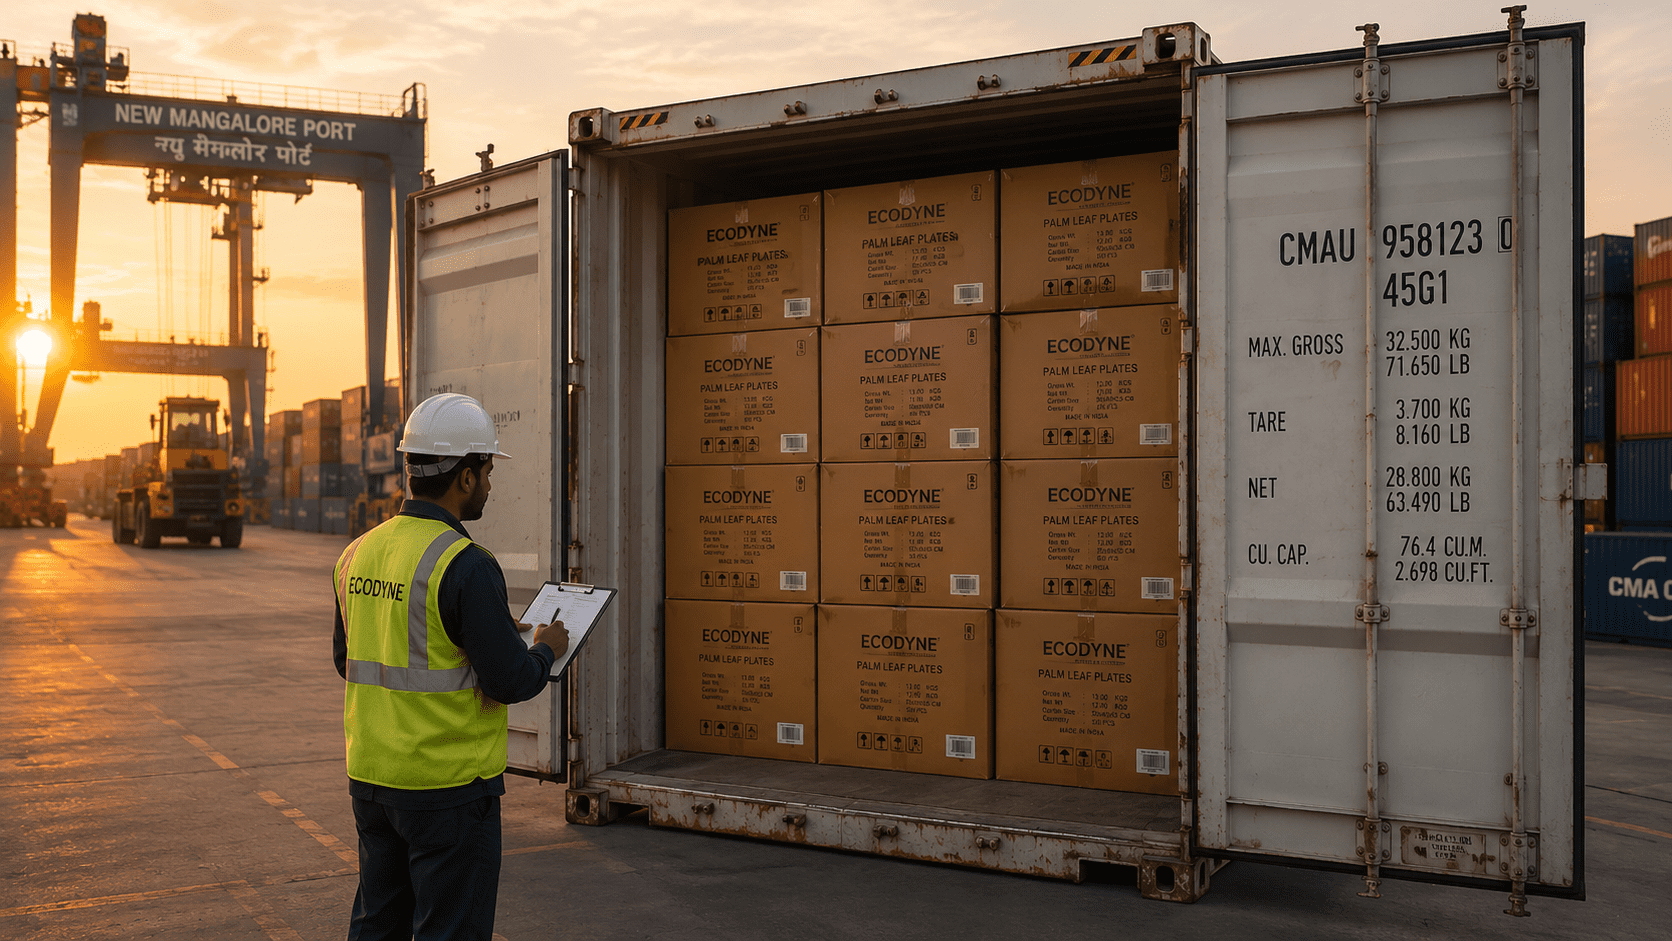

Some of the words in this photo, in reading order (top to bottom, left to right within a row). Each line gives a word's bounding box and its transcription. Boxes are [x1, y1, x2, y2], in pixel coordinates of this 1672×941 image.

[115, 103, 162, 125] NEW
[170, 107, 297, 136] MANGALORE
[303, 119, 356, 141] PORT
[275, 140, 313, 166] पोर्ट
[1048, 183, 1131, 206] ECODYNE
[868, 203, 945, 224] ECODYNE
[1043, 217, 1070, 228] PALM
[1073, 214, 1097, 226] LEAF
[1099, 211, 1138, 223] PLATES
[706, 222, 778, 243] ECODYNE
[862, 237, 888, 249] PALM
[890, 235, 915, 247] LEAF
[1279, 228, 1356, 267] CMAU
[1382, 219, 1483, 259] 958123
[1501, 218, 1512, 250] 0
[1382, 269, 1447, 308] 45G1
[1047, 335, 1131, 354] ECODYNE
[1248, 336, 1286, 358] MAX.
[1292, 333, 1344, 356] GROSS
[1385, 329, 1440, 352] 32.500
[1449, 328, 1471, 349] KG
[704, 356, 773, 373] ECODYNE
[864, 346, 941, 364] ECODYNE
[1043, 366, 1070, 376] PALM
[1072, 364, 1096, 375] LEAF
[1099, 363, 1138, 374] PLATES
[1386, 354, 1440, 377] 71.650
[1449, 353, 1470, 375] LB
[700, 384, 722, 393] PALM
[724, 382, 745, 392] LEAF
[746, 381, 778, 390] PLATES
[859, 375, 885, 385] PALM
[887, 373, 909, 383] LEAF
[912, 371, 947, 383] PLATES
[1248, 411, 1286, 433] TARE
[1395, 398, 1441, 420] 3.700
[1449, 397, 1471, 419] KG
[1395, 423, 1441, 445] 8.160
[1449, 423, 1470, 444] LB
[1248, 477, 1278, 499] NET
[1386, 466, 1441, 488] 28.800
[1450, 466, 1471, 487] KG
[703, 490, 772, 504] ECODYNE
[864, 489, 941, 503] ECODYNE
[1048, 487, 1132, 502] ECODYNE
[1386, 491, 1441, 513] 63.490
[1450, 491, 1471, 513] LB
[699, 515, 722, 524] PALM
[723, 515, 744, 524] LEAF
[745, 515, 778, 524] PLATES
[858, 515, 884, 525] PALM
[885, 515, 909, 525] LEAF
[911, 515, 947, 525] PLATES
[1043, 515, 1070, 525] PALM
[1073, 515, 1098, 525] LEAF
[1100, 515, 1139, 525] PLATES
[1248, 543, 1272, 565] CU.
[1277, 544, 1309, 565] CAP.
[1400, 535, 1436, 557] 76.4
[1444, 536, 1487, 557] CU.M.
[1395, 561, 1438, 582] 2.698
[1444, 562, 1493, 583] CU.FT.
[349, 577, 405, 602] ECODYNE
[1608, 576, 1659, 599] CMA
[702, 629, 770, 645] ECODYNE
[861, 634, 937, 652] ECODYNE
[1043, 640, 1126, 659] ECODYNE
[698, 654, 721, 663] PALM
[722, 655, 743, 664] LEAF
[744, 656, 775, 666] PLATES
[856, 660, 881, 671] PALM
[883, 662, 906, 672] LEAF
[907, 663, 943, 674] PLATES
[1038, 668, 1065, 680] PALM
[1067, 670, 1092, 681] LEAF
[1094, 671, 1132, 683] PLATES
